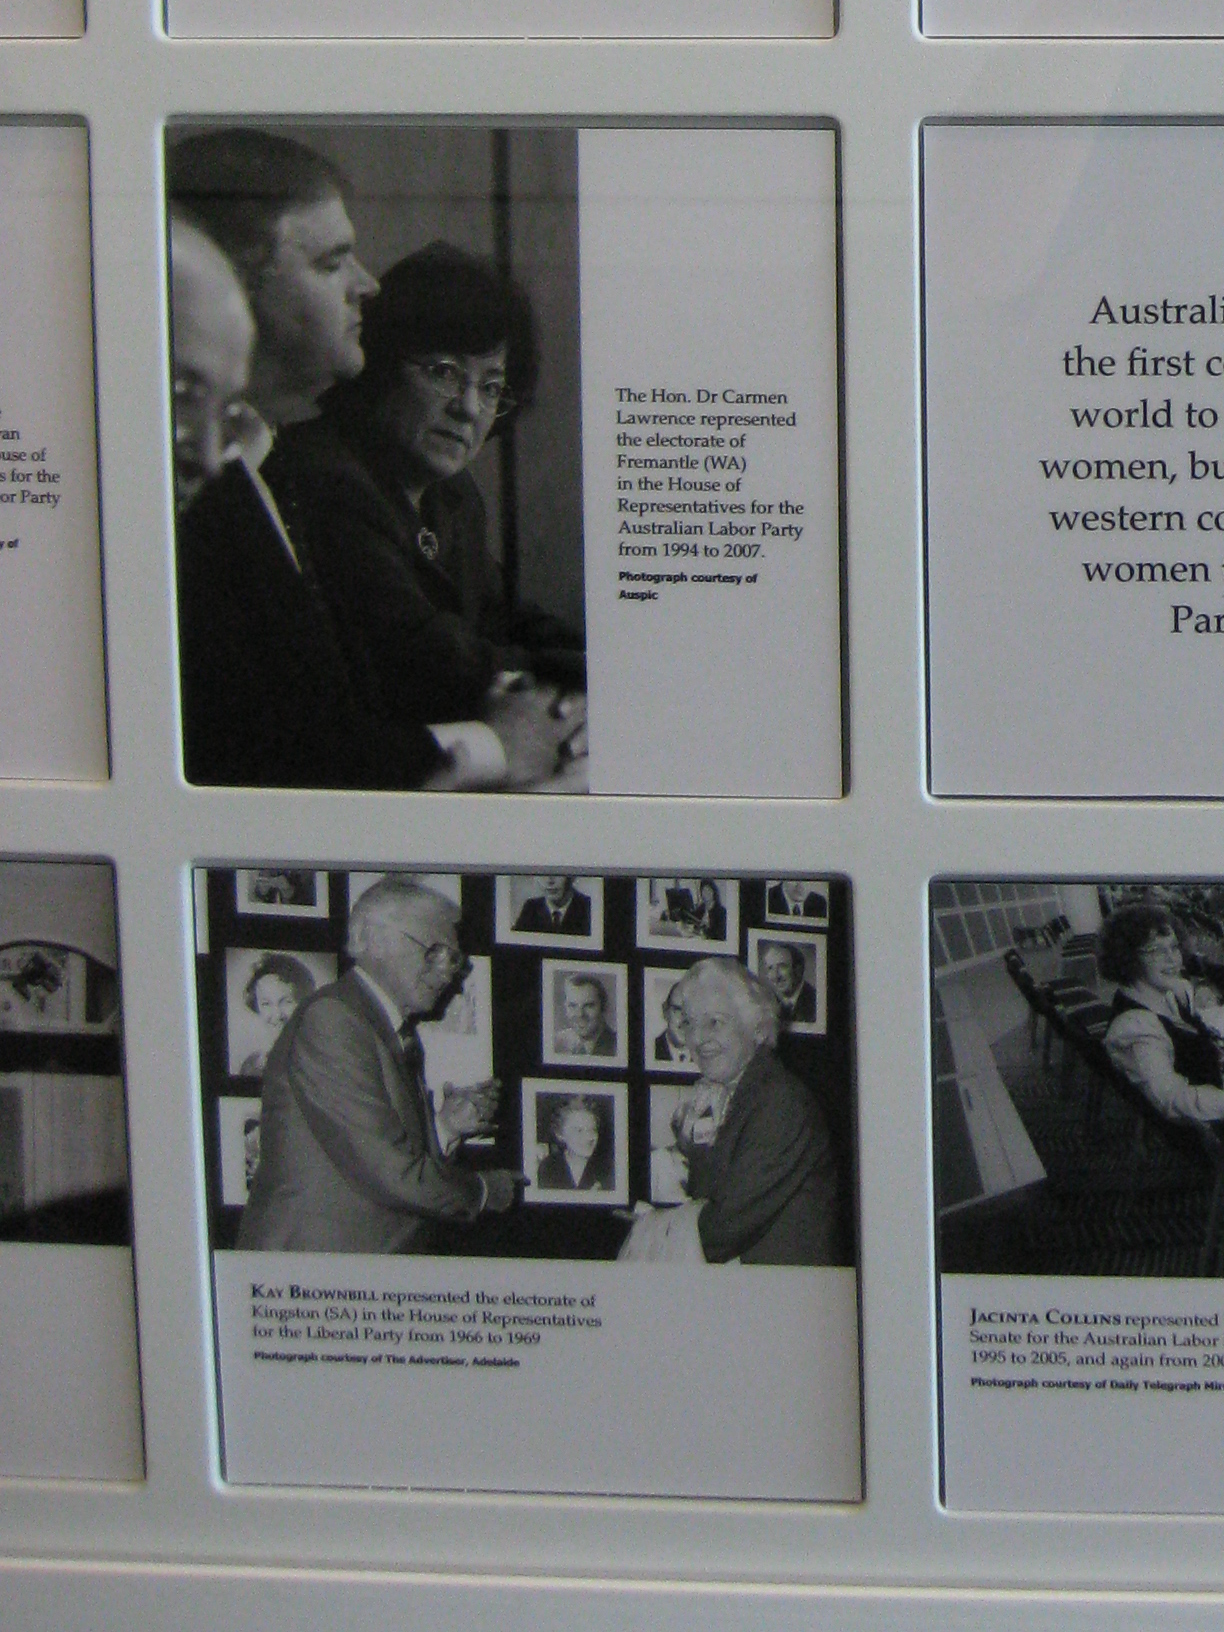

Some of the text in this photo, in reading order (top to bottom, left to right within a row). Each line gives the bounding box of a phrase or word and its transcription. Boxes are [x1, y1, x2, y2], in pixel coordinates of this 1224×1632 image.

[1063, 345, 1116, 376] the
[1128, 347, 1195, 376] first
[615, 387, 788, 405] The Hon. Dr Carmen
[617, 410, 796, 430] Lawrence represented
[1070, 399, 1173, 428] world
[1185, 403, 1218, 428] to
[616, 432, 746, 448] the electorate of
[31, 448, 46, 462] of
[617, 454, 747, 473] Fremantle (WA)
[11, 469, 61, 483] for the
[1039, 460, 1177, 485] women,
[20, 489, 61, 509] Party
[1049, 506, 1186, 531] western
[619, 572, 757, 584] Photograph courtesy of
[1082, 562, 1211, 582] women
[618, 589, 658, 602] Auspic
[382, 1290, 470, 1306] represented
[476, 1290, 499, 1306] the
[503, 1291, 576, 1308] electorate
[580, 1295, 596, 1308] of
[1125, 1313, 1219, 1331] represented
[971, 1377, 1038, 1389] Photograph
[1042, 1381, 1091, 1390] courtesy
[1095, 1380, 1106, 1388] of
[1110, 1380, 1138, 1391] Daily
[1144, 1381, 1201, 1393] Telegraph
